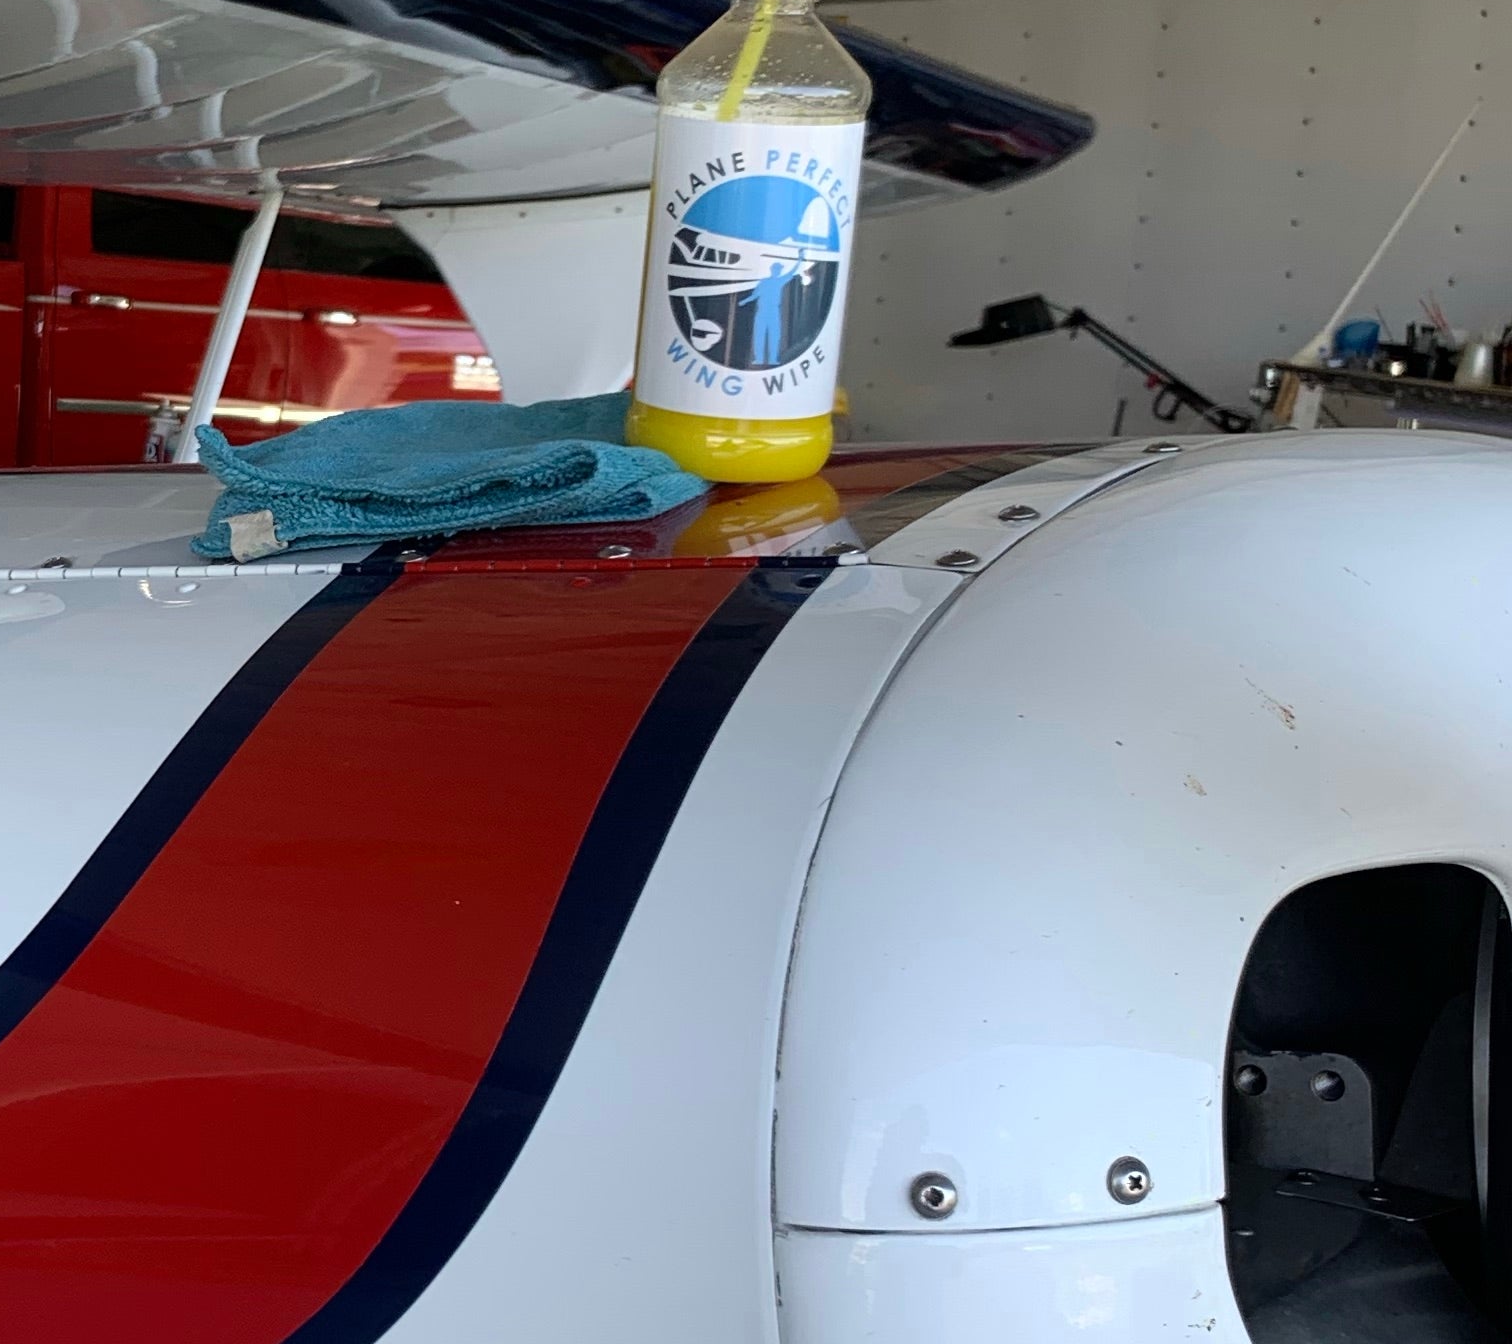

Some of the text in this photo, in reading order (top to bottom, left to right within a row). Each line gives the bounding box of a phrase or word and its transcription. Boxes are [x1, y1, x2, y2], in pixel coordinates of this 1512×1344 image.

[666, 149, 852, 230] PLANE PERFECT
[666, 337, 826, 397] WING WIPE
